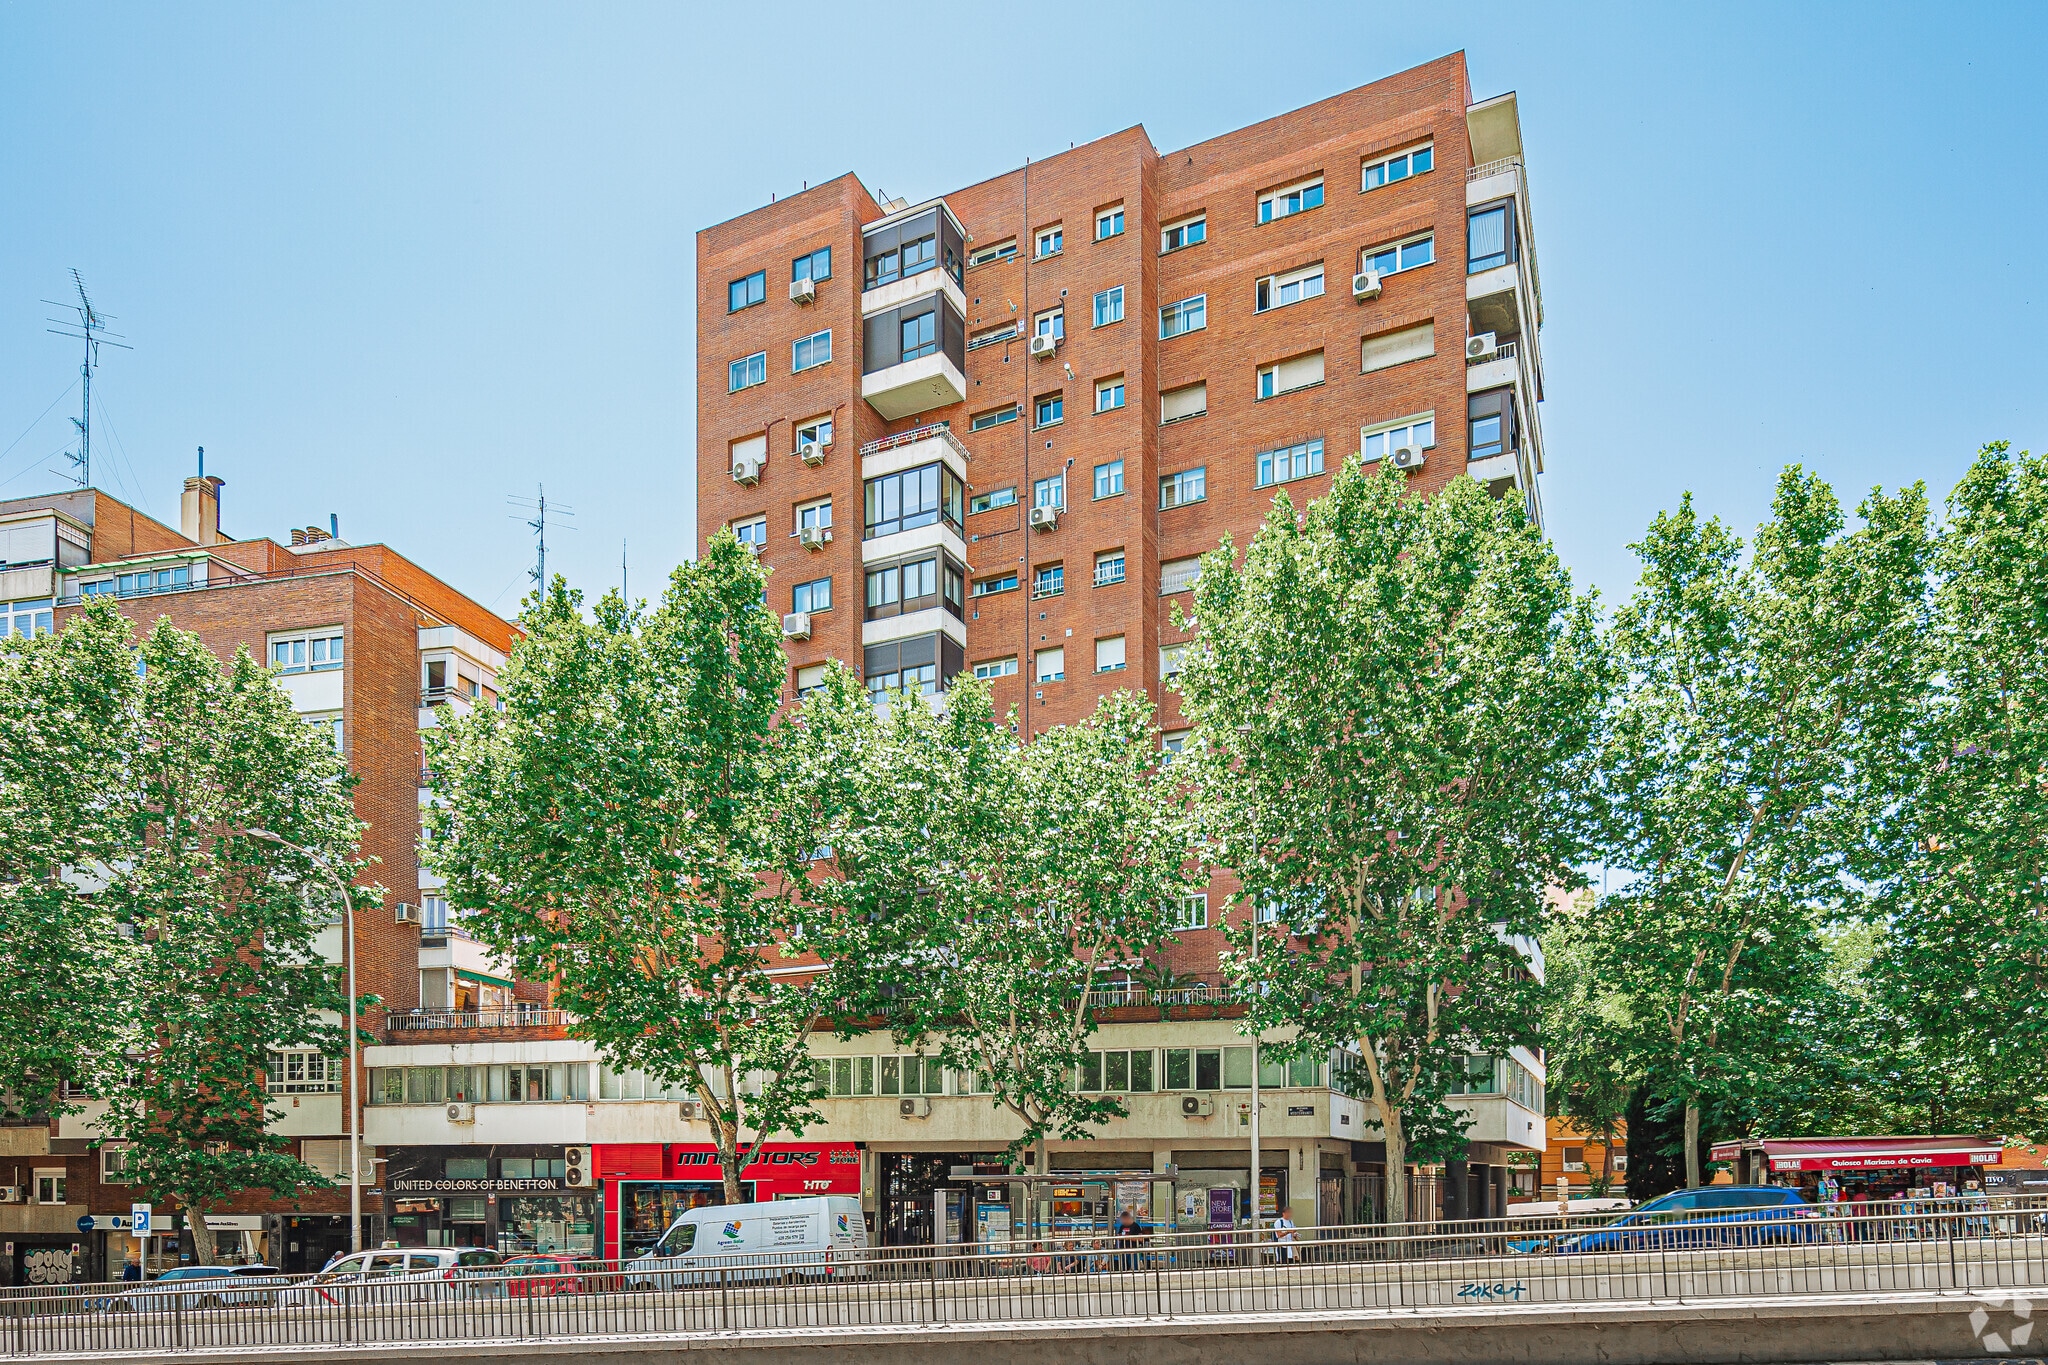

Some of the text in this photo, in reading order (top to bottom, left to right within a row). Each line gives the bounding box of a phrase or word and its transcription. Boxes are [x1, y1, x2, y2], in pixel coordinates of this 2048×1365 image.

[829, 1156, 859, 1165] STORE
[1864, 1158, 1895, 1166] Mariano
[393, 1180, 433, 1190] UNITED
[435, 1180, 478, 1190] COLORS
[480, 1180, 495, 1190] OF
[134, 1213, 145, 1229] P
